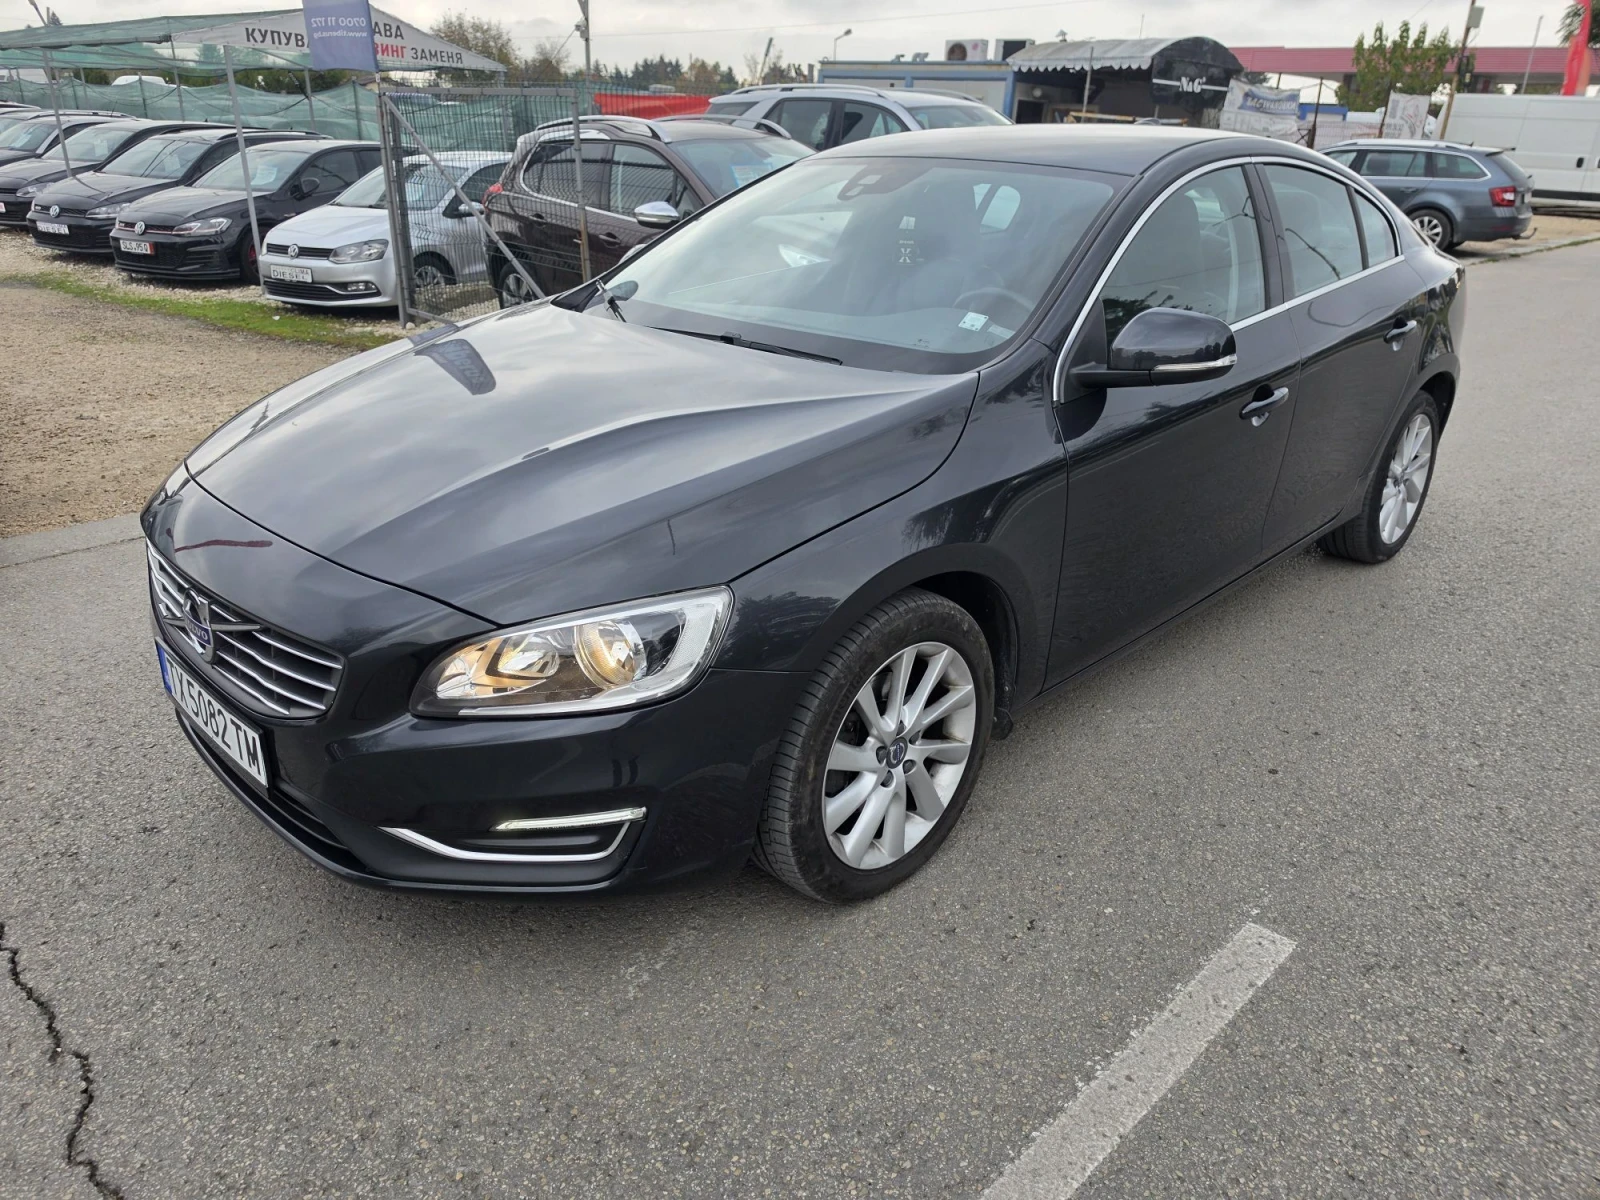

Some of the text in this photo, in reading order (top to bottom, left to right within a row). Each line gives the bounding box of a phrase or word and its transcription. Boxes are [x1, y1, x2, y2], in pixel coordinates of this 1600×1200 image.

[245, 21, 404, 48] КУПУВ АВА
[410, 47, 463, 64] ЗАМЕНЯ
[272, 269, 308, 281] DIESEL
